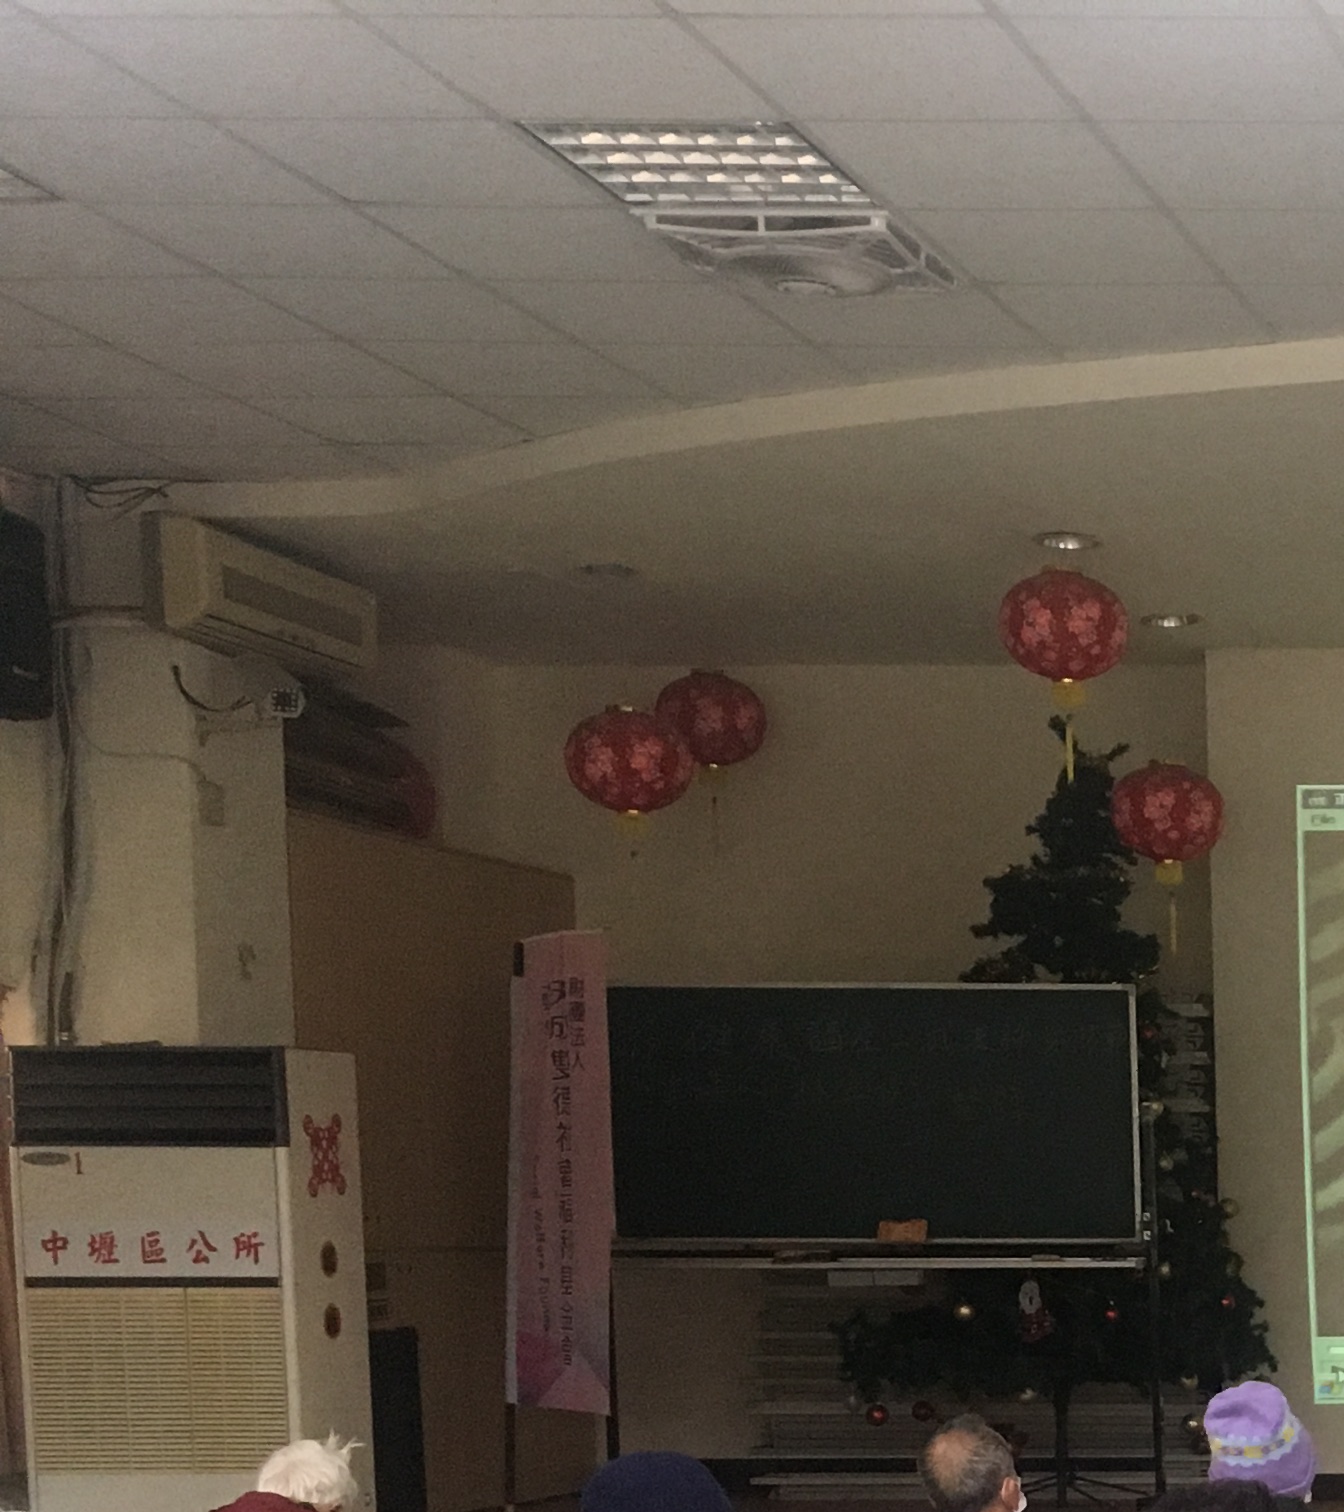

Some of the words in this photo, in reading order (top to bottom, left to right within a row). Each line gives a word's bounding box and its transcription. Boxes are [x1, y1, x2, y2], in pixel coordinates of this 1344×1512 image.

[1310, 814, 1337, 825] File
[40, 1229, 266, 1266] 中壢區公所
